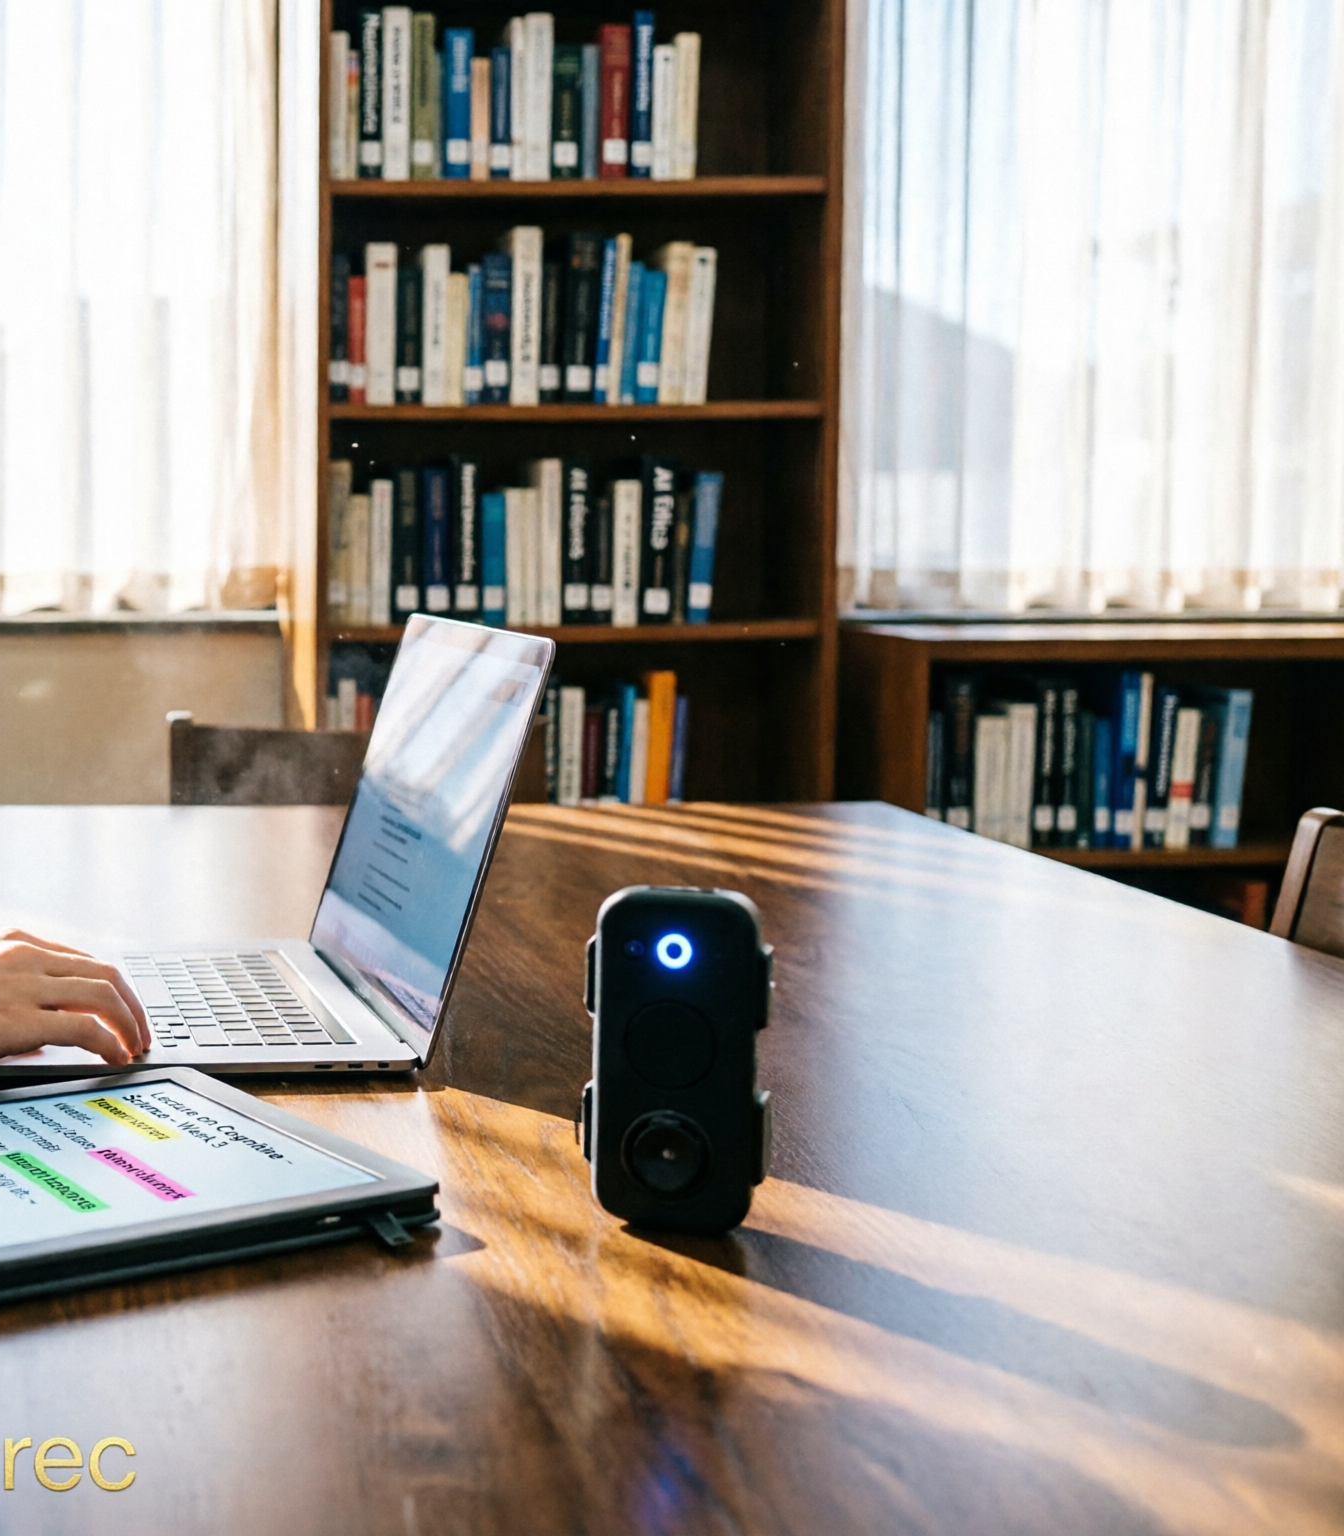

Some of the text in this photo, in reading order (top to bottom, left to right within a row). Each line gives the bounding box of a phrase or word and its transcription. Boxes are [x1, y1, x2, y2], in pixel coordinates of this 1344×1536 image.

[150, 1091, 197, 1117] Lecture
[196, 1116, 217, 1127] on
[211, 1140, 229, 1149] 3
